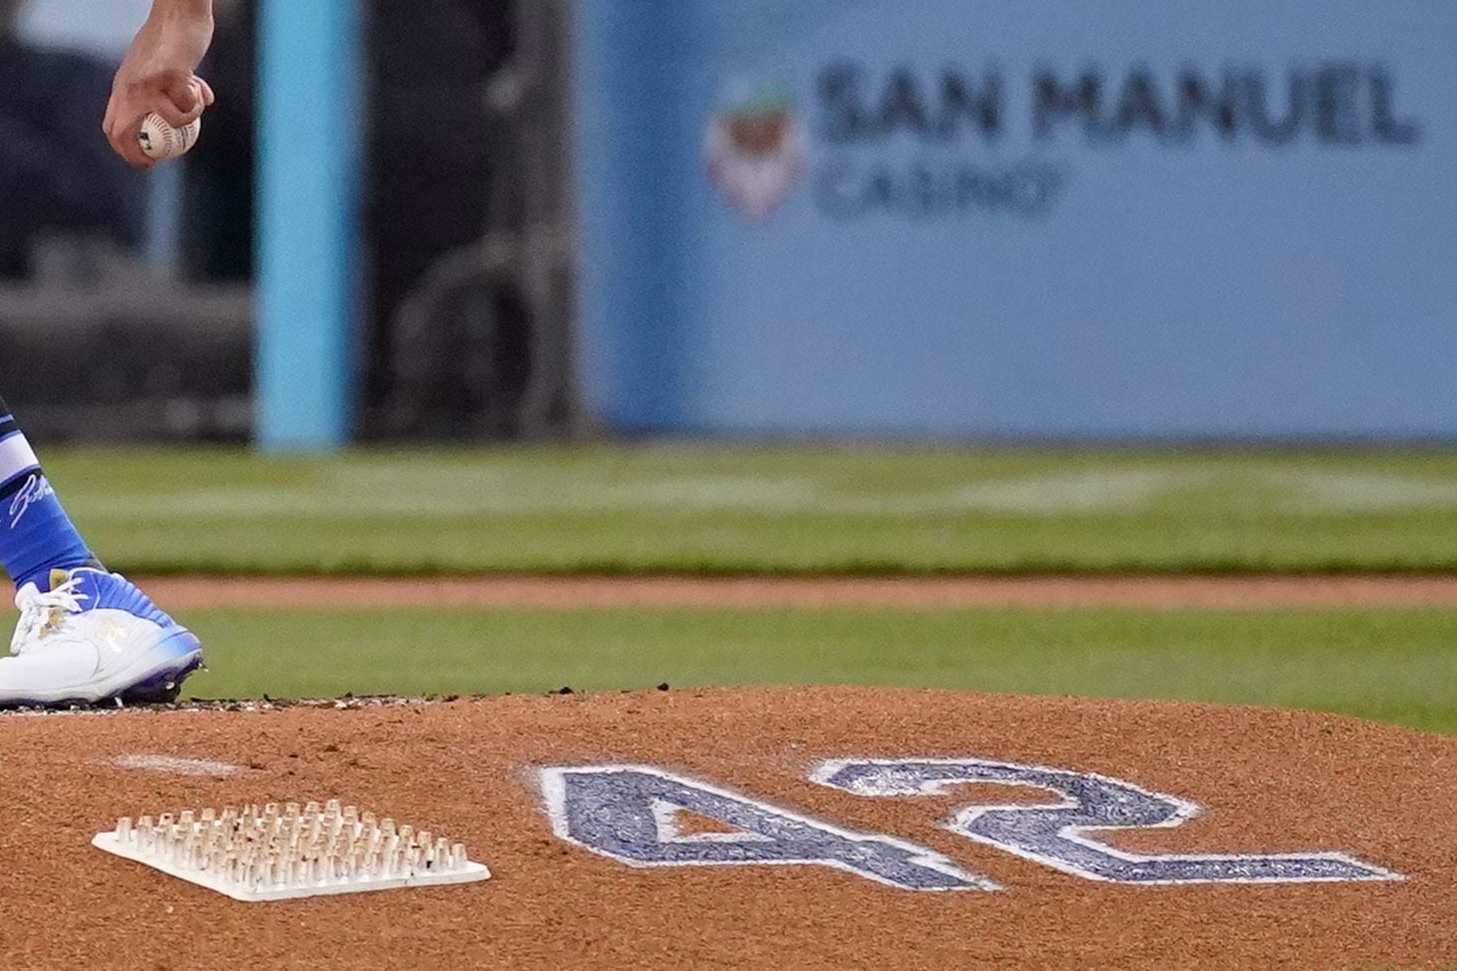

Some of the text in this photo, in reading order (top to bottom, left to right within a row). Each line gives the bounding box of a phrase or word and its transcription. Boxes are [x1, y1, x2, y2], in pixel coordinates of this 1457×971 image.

[814, 61, 1423, 149] SAN MANUEL
[540, 758, 1411, 892] 42
